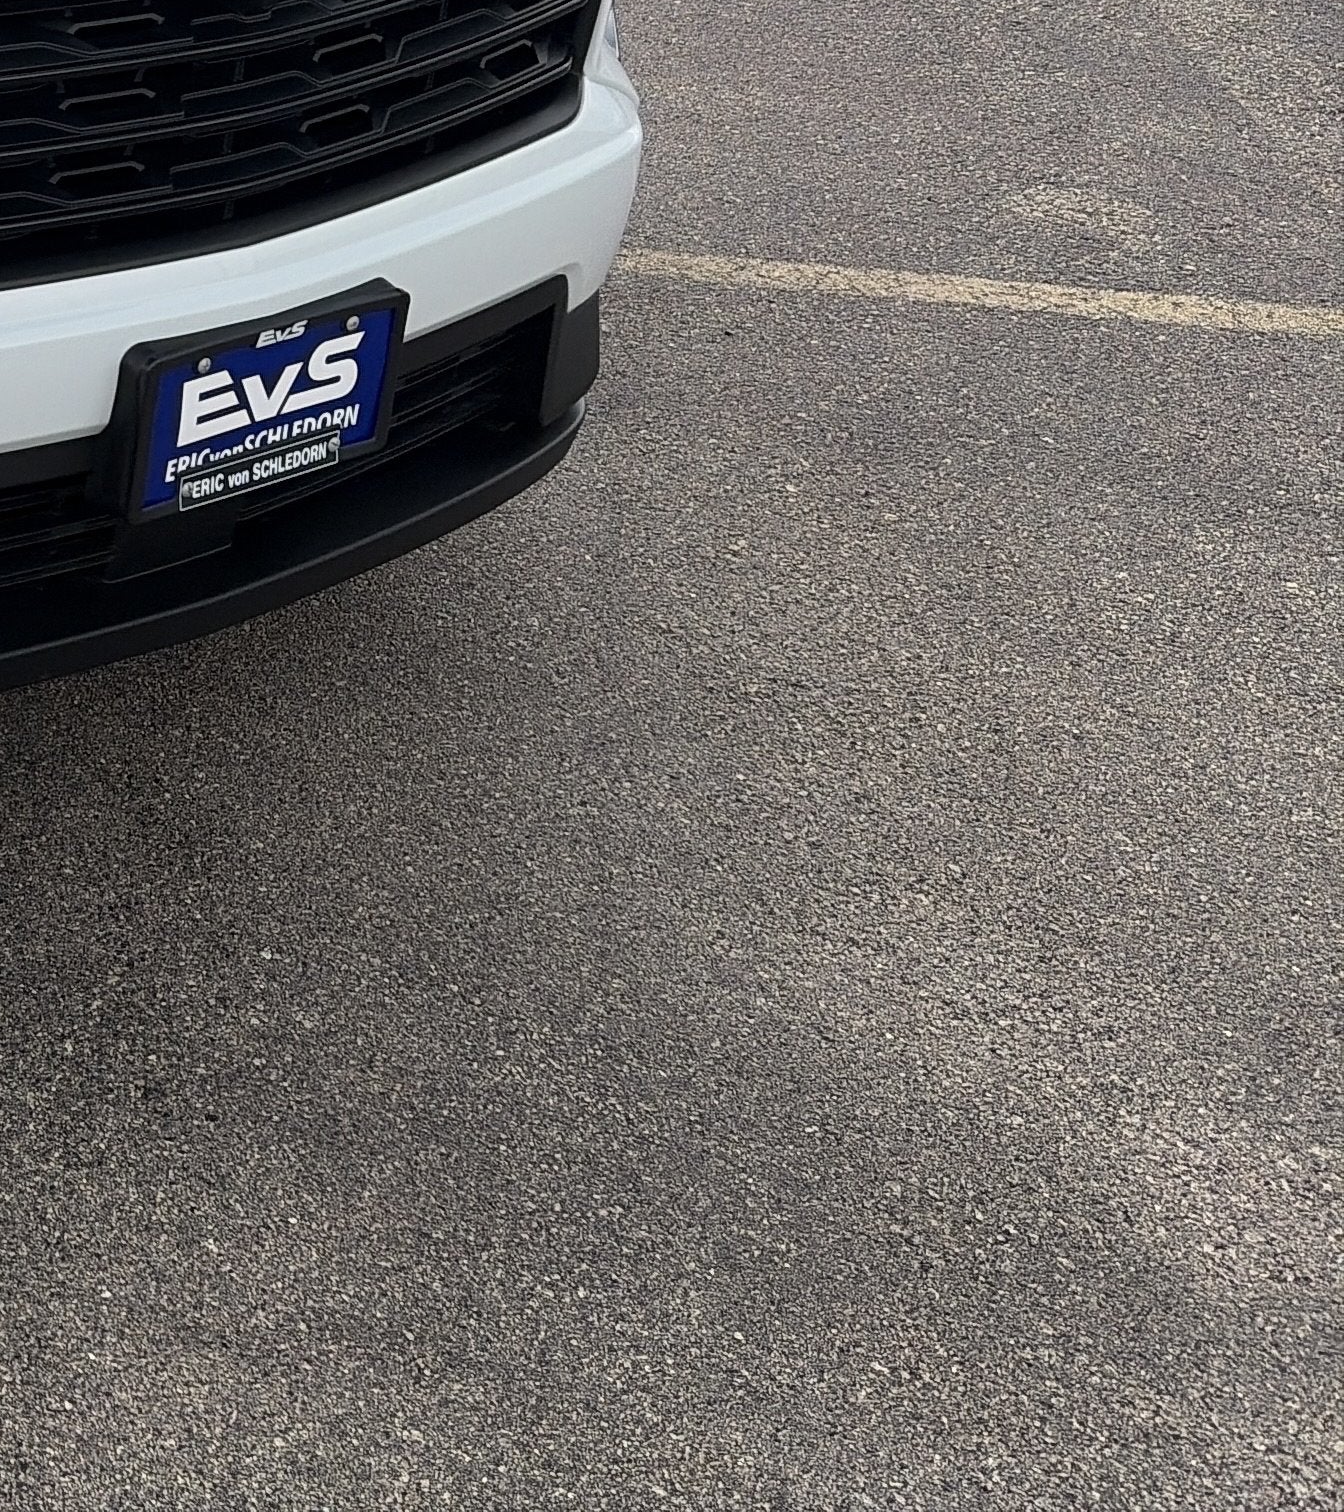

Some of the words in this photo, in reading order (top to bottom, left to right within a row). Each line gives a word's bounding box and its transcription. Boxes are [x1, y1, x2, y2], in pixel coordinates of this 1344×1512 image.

[191, 472, 225, 499] ERIC
[228, 470, 250, 489] von
[252, 441, 328, 481] SCHLEDORN
